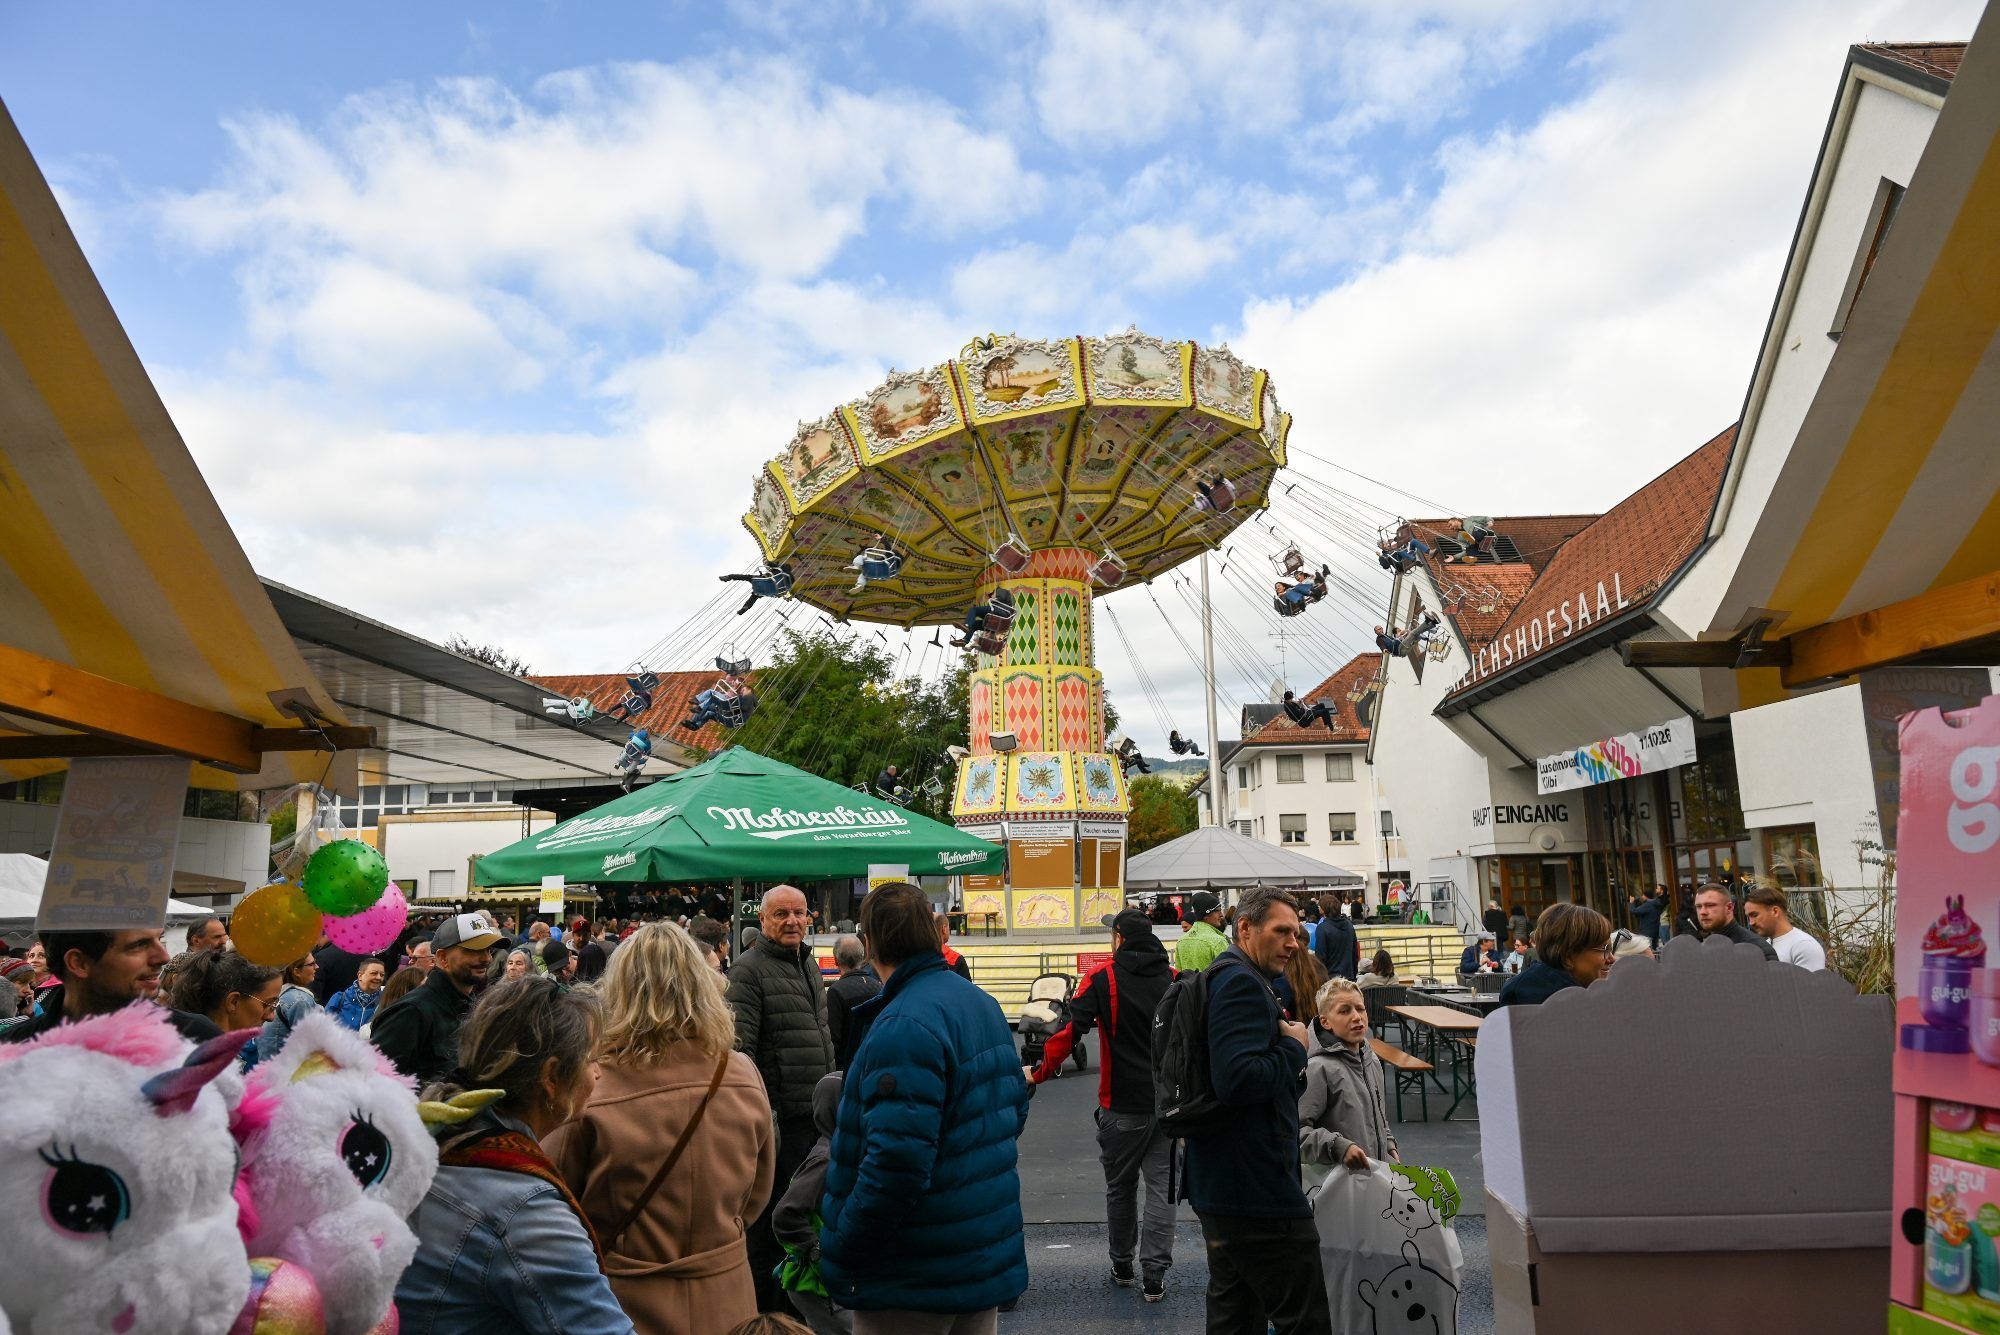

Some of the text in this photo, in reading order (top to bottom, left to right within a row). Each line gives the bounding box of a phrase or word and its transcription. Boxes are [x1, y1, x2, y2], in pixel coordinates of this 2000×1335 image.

[706, 805, 908, 830] Mohrenbräu
[1472, 804, 1569, 827] HAUPT EINGANG
